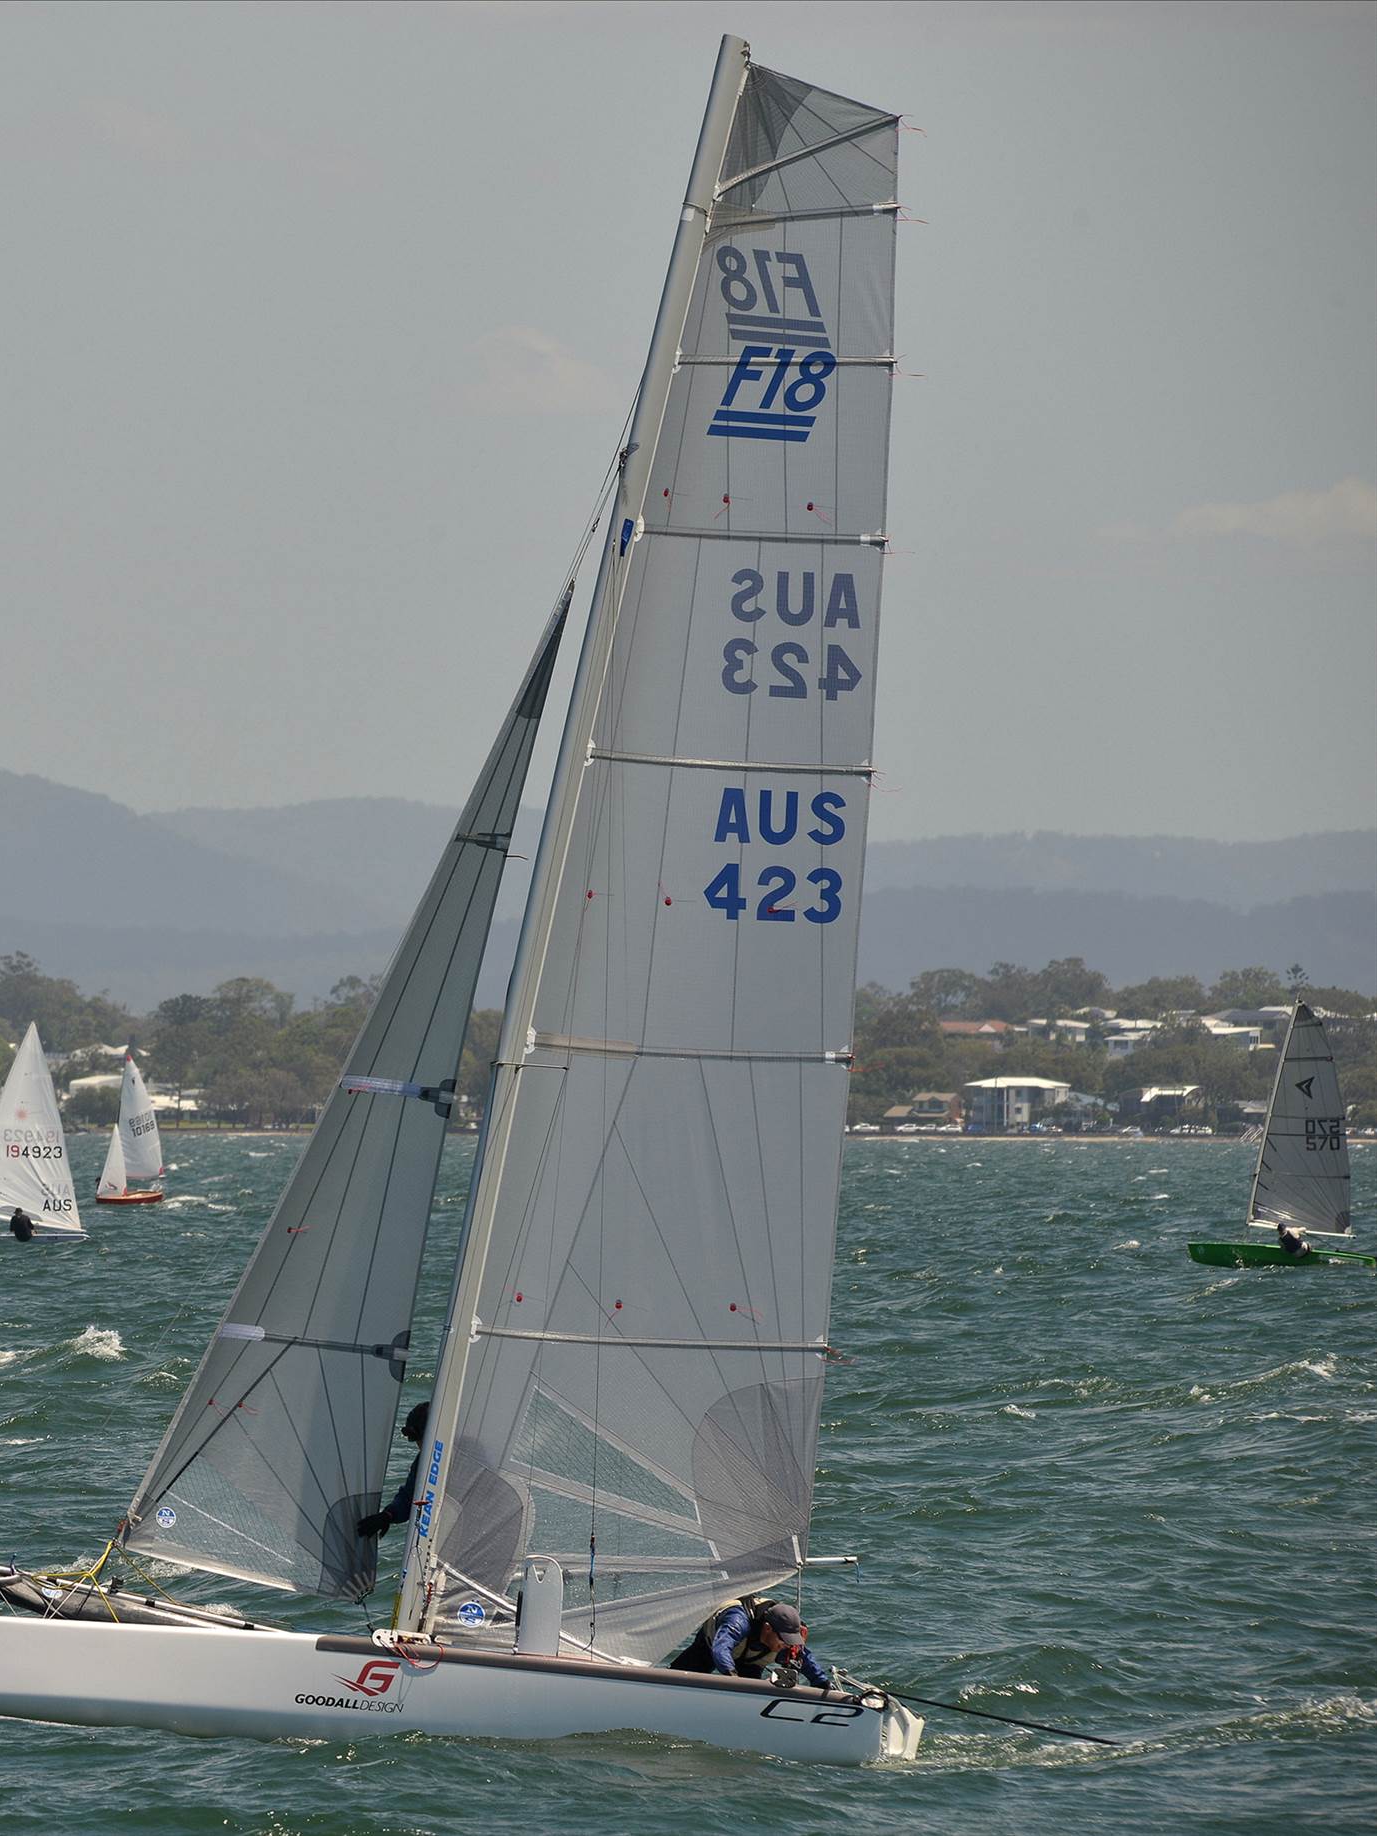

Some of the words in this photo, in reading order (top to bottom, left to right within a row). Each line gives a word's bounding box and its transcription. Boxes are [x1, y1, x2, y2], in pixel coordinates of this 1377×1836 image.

[720, 345, 837, 412] F18
[714, 787, 847, 846] AUS
[703, 863, 843, 924] 423
[6, 1144, 63, 1159] 194923
[1305, 1135, 1340, 1151] 570
[43, 1199, 72, 1212] AUS
[428, 1440, 443, 1486] EDGE
